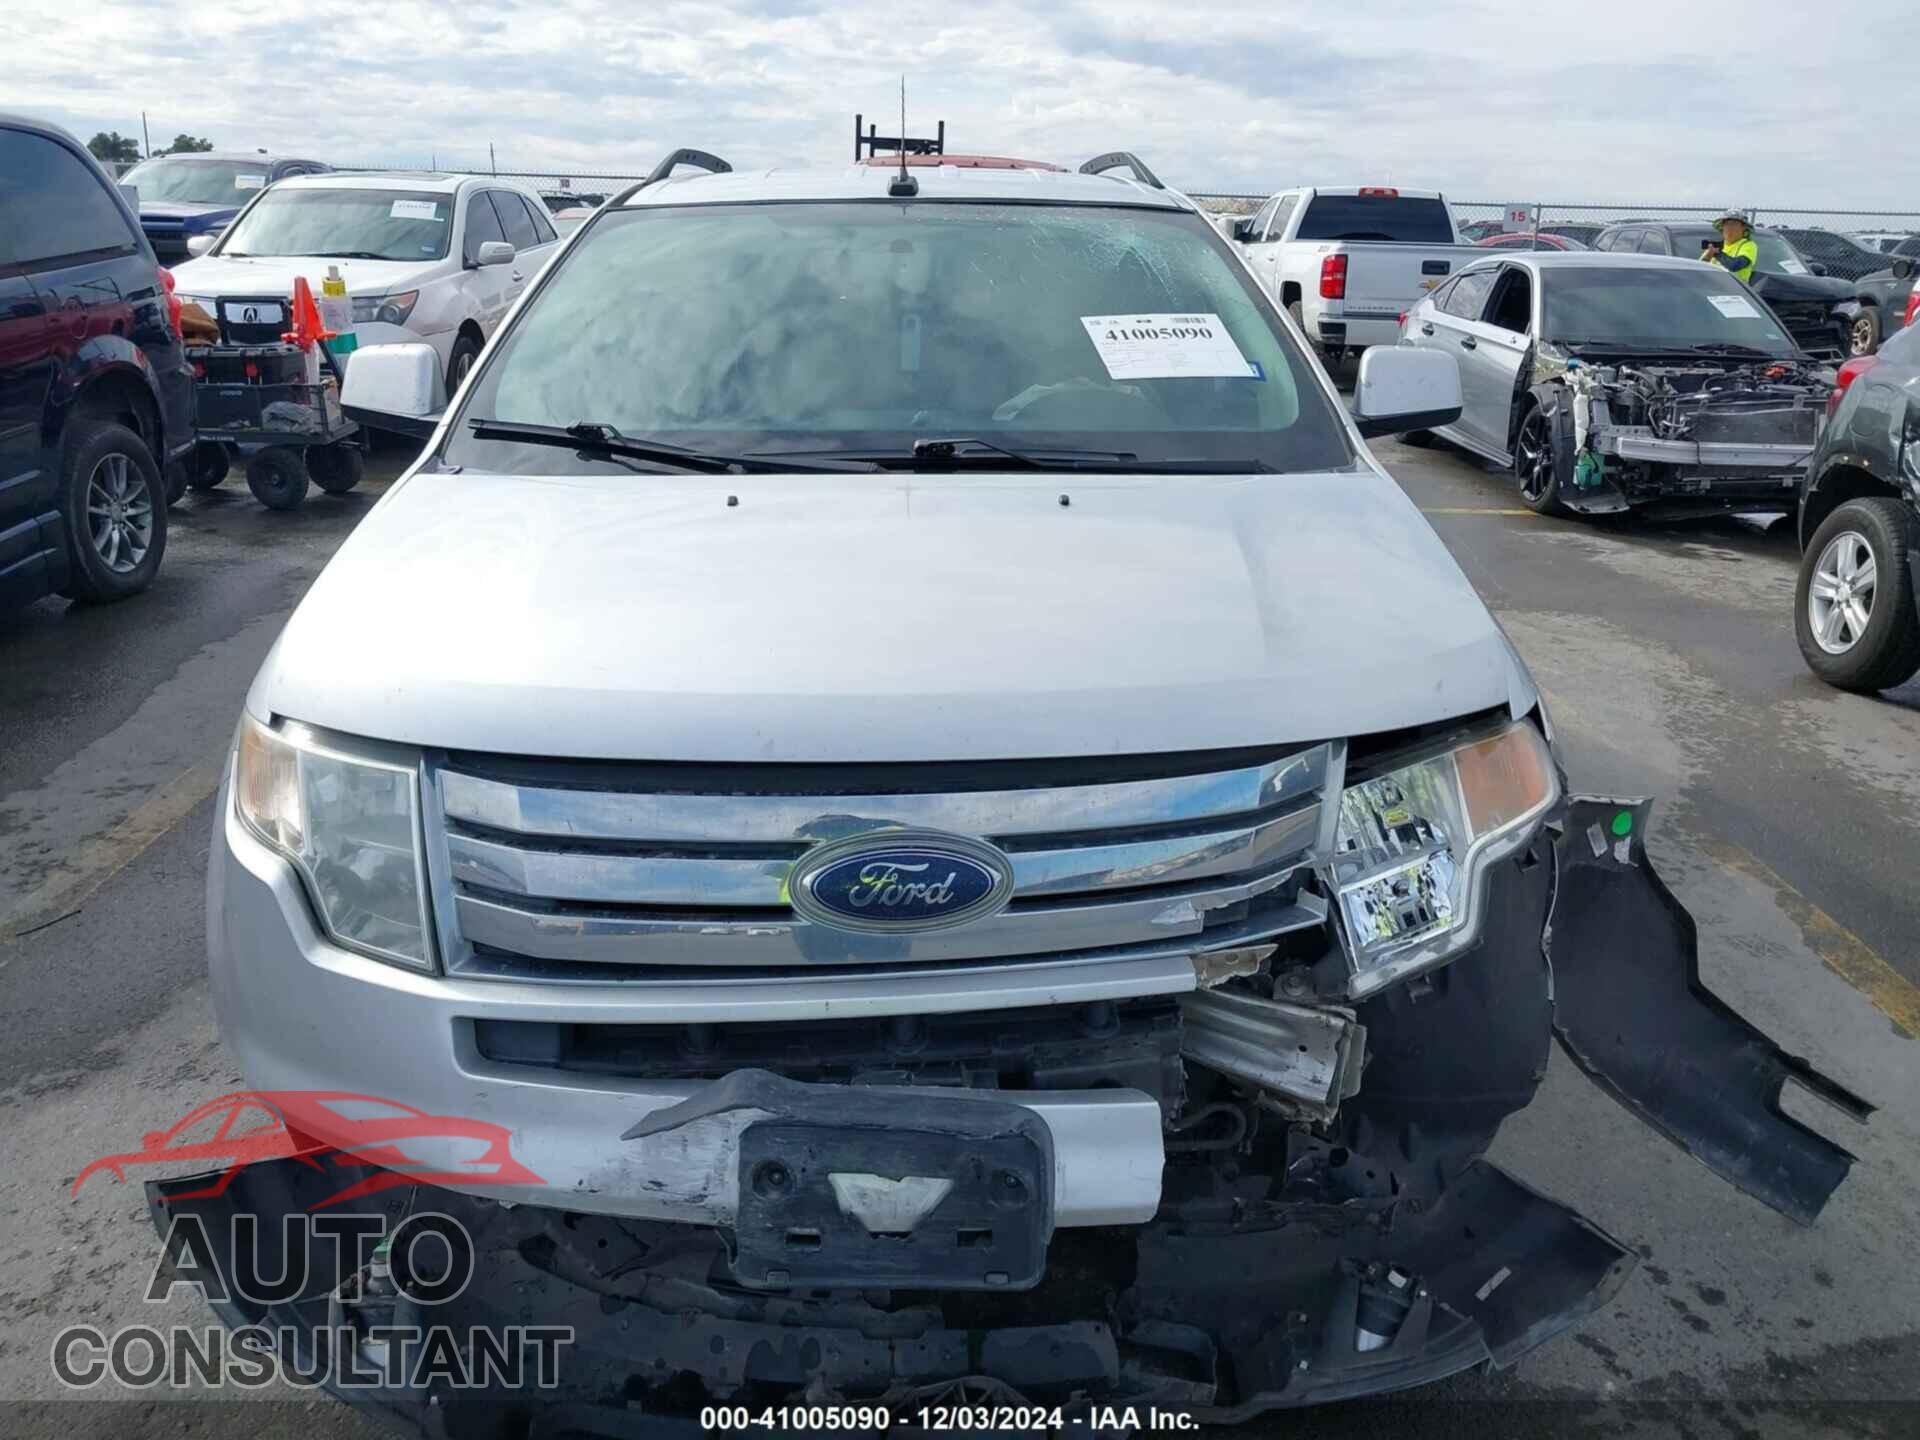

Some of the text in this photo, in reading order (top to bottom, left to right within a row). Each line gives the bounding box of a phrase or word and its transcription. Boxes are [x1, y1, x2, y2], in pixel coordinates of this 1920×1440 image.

[1510, 211, 1526, 223] 15
[1105, 327, 1213, 341] 41005090
[849, 862, 956, 908] Ford
